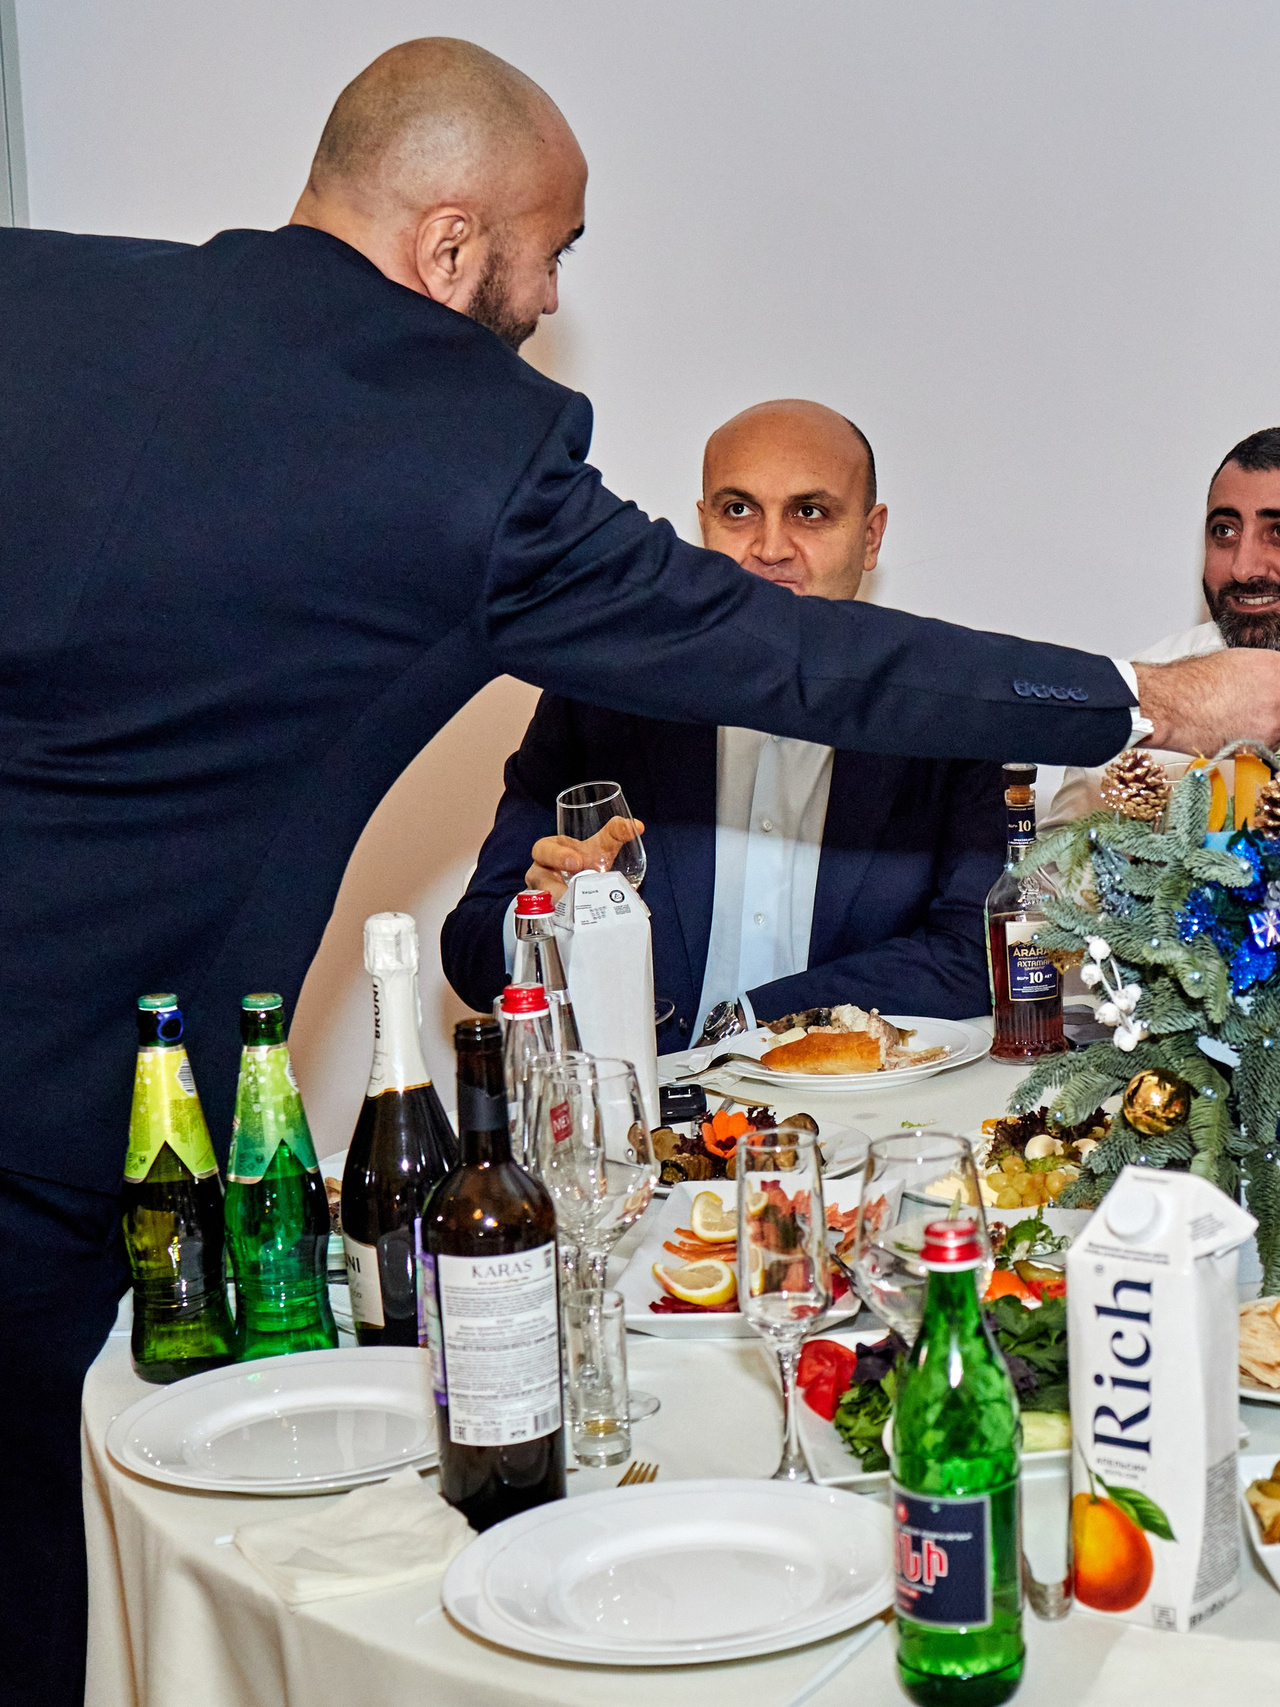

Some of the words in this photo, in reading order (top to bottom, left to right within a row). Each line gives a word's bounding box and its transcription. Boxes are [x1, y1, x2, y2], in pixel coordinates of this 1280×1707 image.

[1017, 820, 1032, 832] 10
[1012, 947, 1050, 958] ARARA
[1028, 971, 1044, 984] 10
[471, 1259, 533, 1279] KARAS
[1094, 1278, 1152, 1457] Rich
